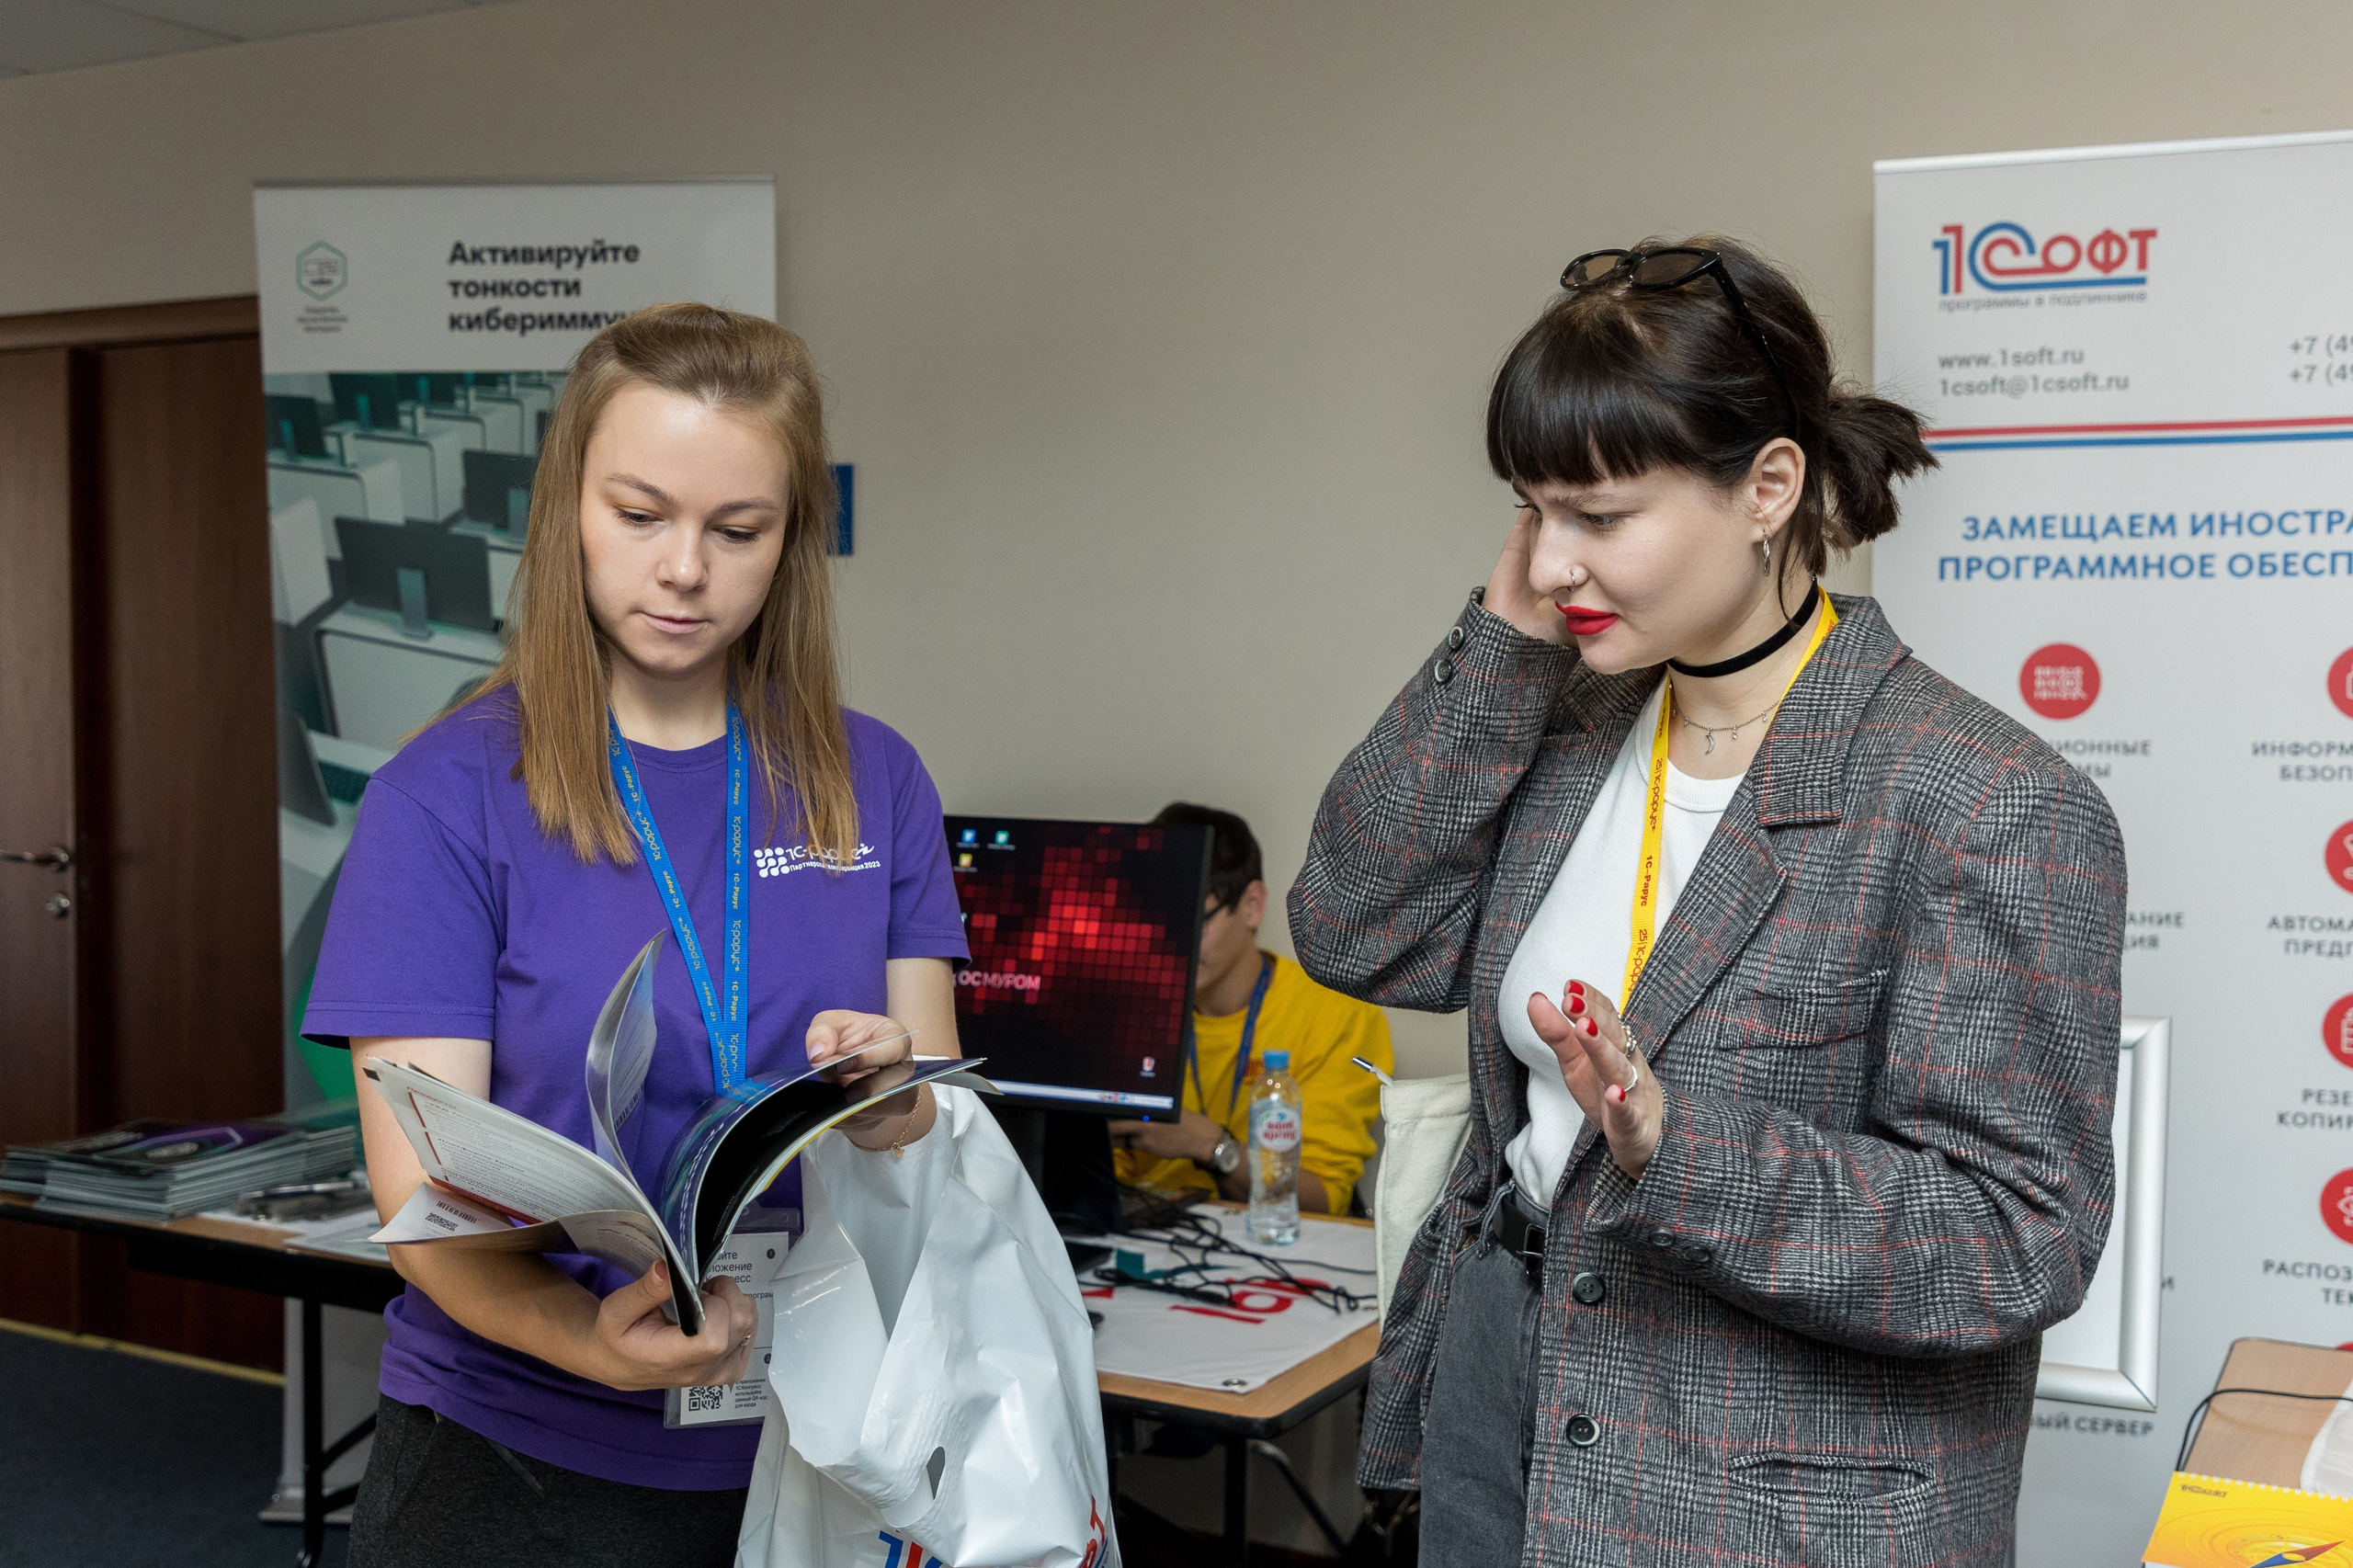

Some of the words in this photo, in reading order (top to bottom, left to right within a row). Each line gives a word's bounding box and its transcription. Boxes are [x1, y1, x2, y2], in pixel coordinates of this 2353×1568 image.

[449, 239, 642, 269] Активируйте
[449, 278, 582, 298] тонкости
[1938, 295, 2030, 312] программы
[2034, 295, 2045, 306] в
[449, 305, 629, 336] киберимму
[1938, 346, 2086, 369] www.1soft.ru
[2289, 335, 2318, 356] +7
[2325, 333, 2353, 359] (4
[1939, 371, 2131, 399] 1csoft@1csoft.ru
[2289, 363, 2318, 384] +7
[2325, 361, 2353, 387] (4
[1961, 511, 2177, 543] ЗАМЕЩАЕМ
[1938, 552, 2216, 582] ПРОГРАММНОЕ
[790, 860, 826, 872] Партнерска
[864, 860, 881, 869] 2023
[1641, 855, 1654, 907] 1С-Рарус
[2262, 1258, 2353, 1283] РАСПОЗ
[2074, 1415, 2154, 1436] СЕРВЕР
